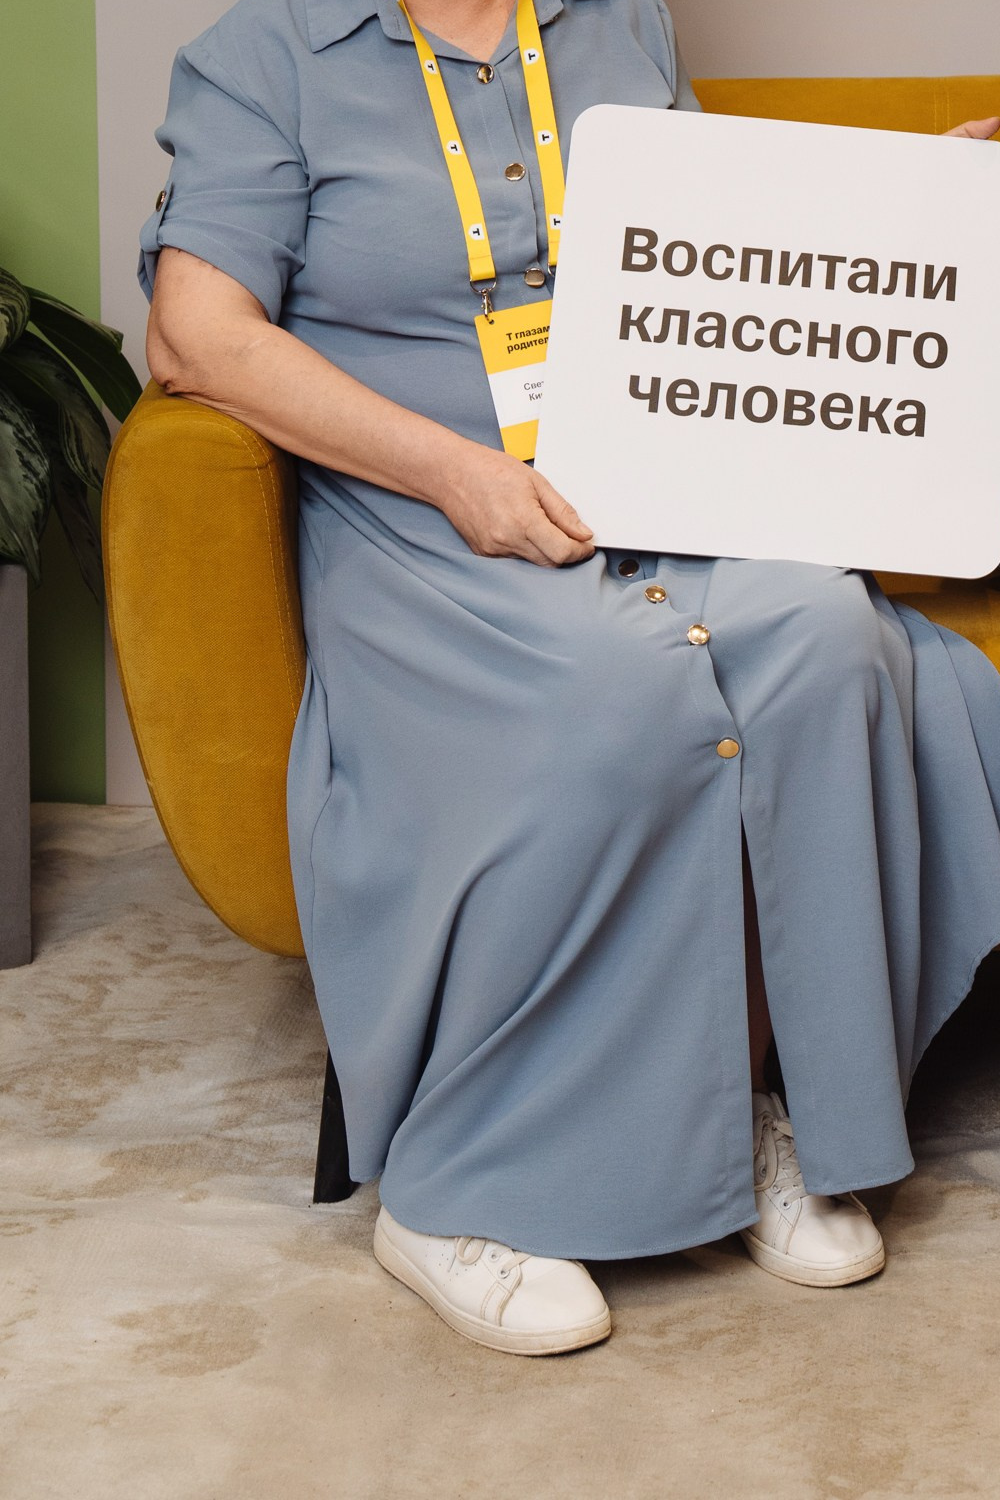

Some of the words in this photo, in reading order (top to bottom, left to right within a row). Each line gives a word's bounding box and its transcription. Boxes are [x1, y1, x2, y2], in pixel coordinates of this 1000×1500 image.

[621, 227, 958, 302] Воспитали
[514, 325, 551, 340] глазам
[618, 304, 949, 370] классного
[506, 336, 549, 354] родител
[523, 380, 544, 391] Све
[528, 392, 543, 402] Ки
[628, 374, 928, 438] человека
